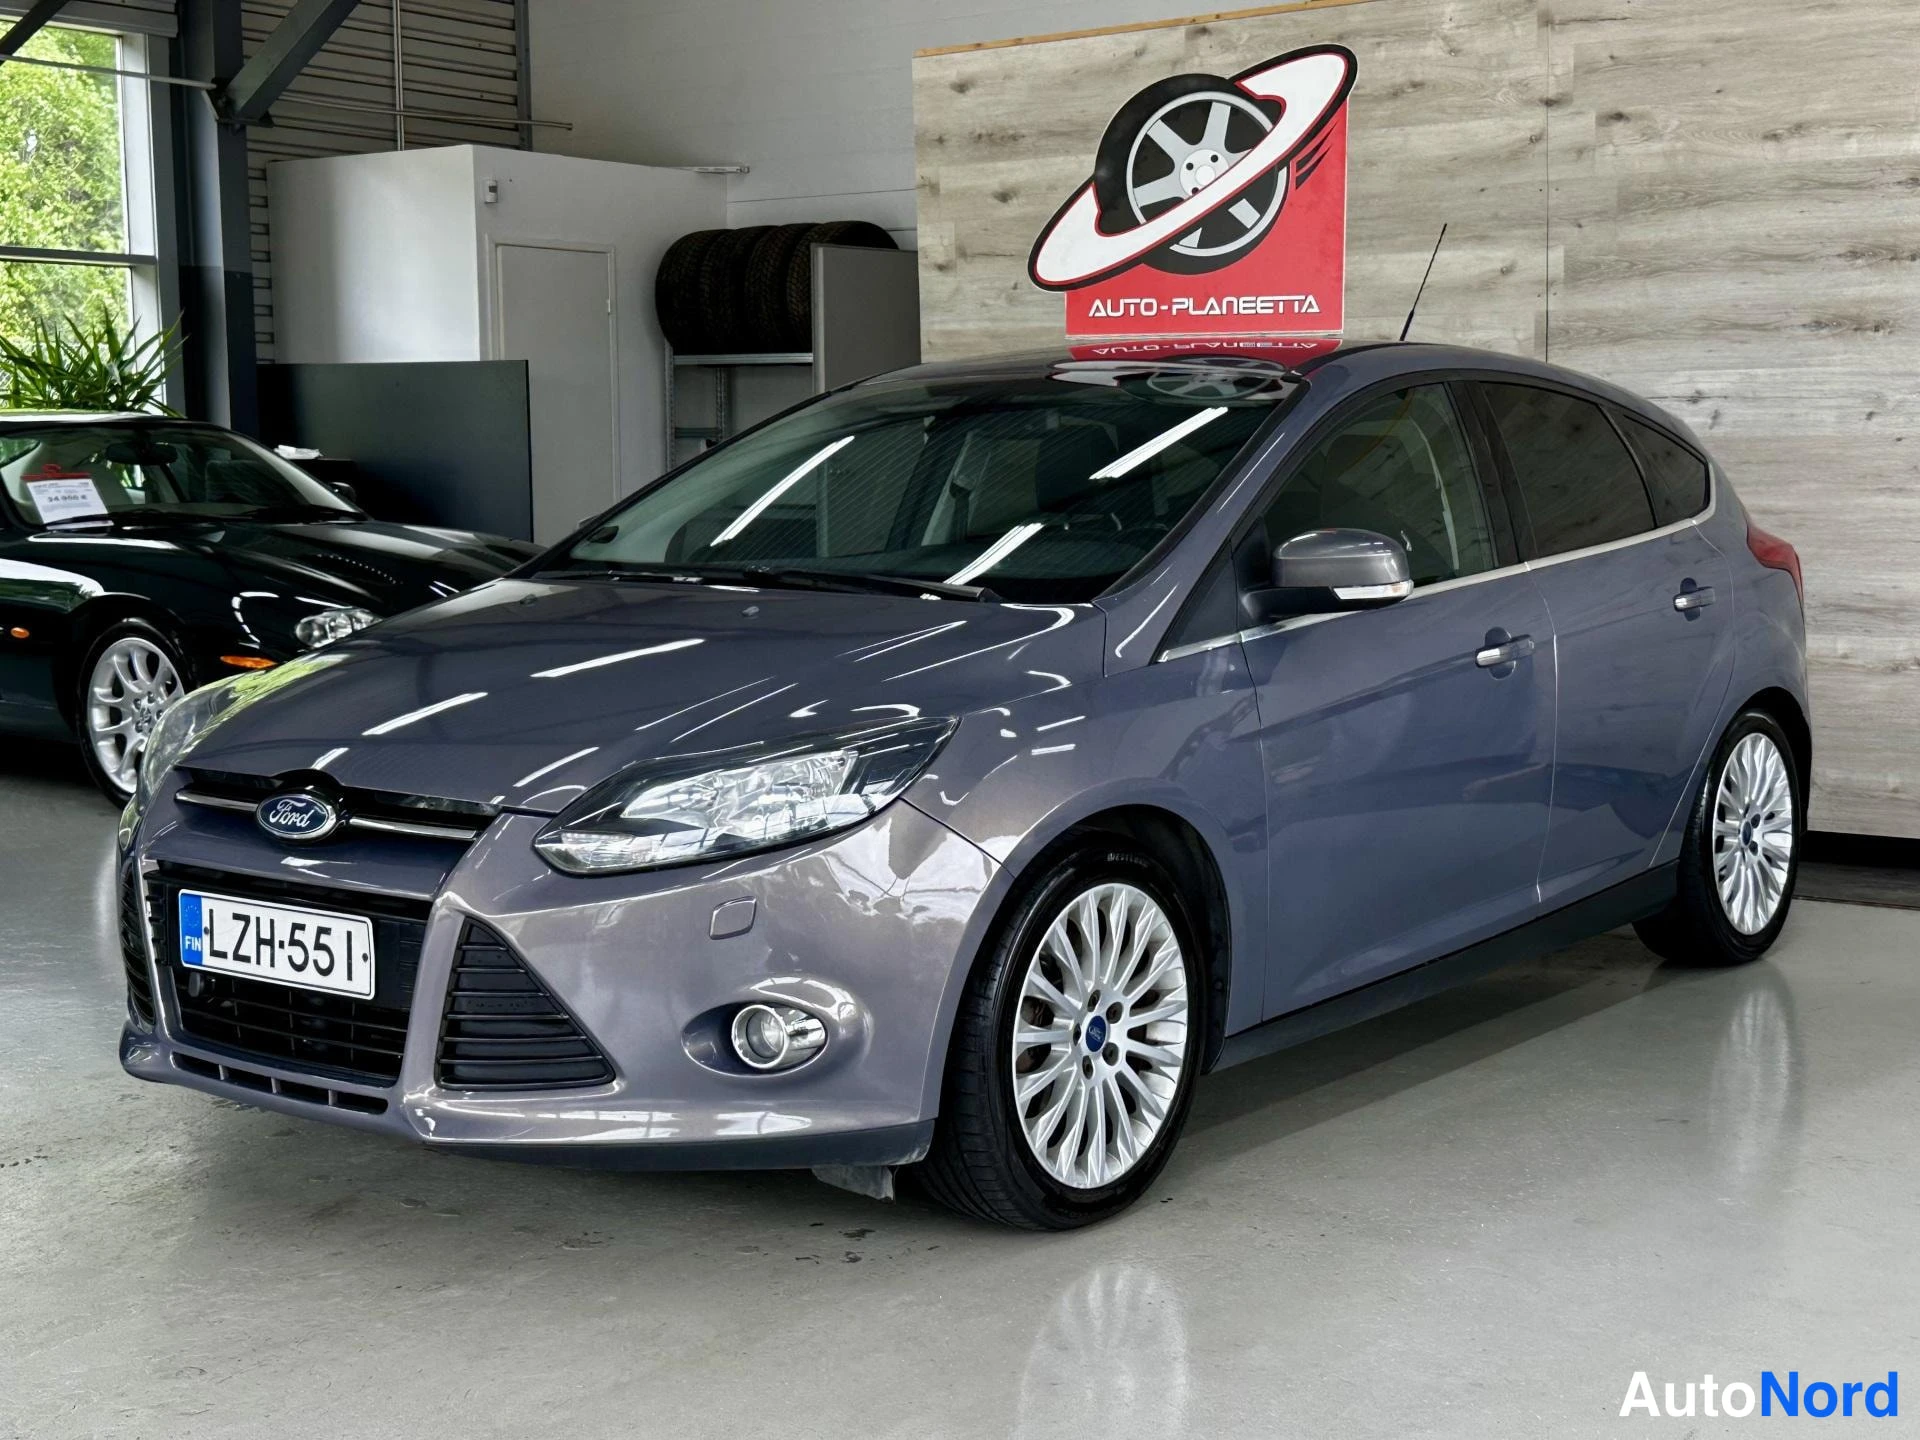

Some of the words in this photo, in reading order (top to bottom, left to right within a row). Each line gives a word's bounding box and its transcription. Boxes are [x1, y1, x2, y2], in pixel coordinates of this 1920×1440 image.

[1088, 294, 1321, 318] AUTO-PLANEETTA
[268, 798, 316, 828] Ford
[184, 935, 201, 951] FIN
[208, 908, 353, 982] LZH-551
